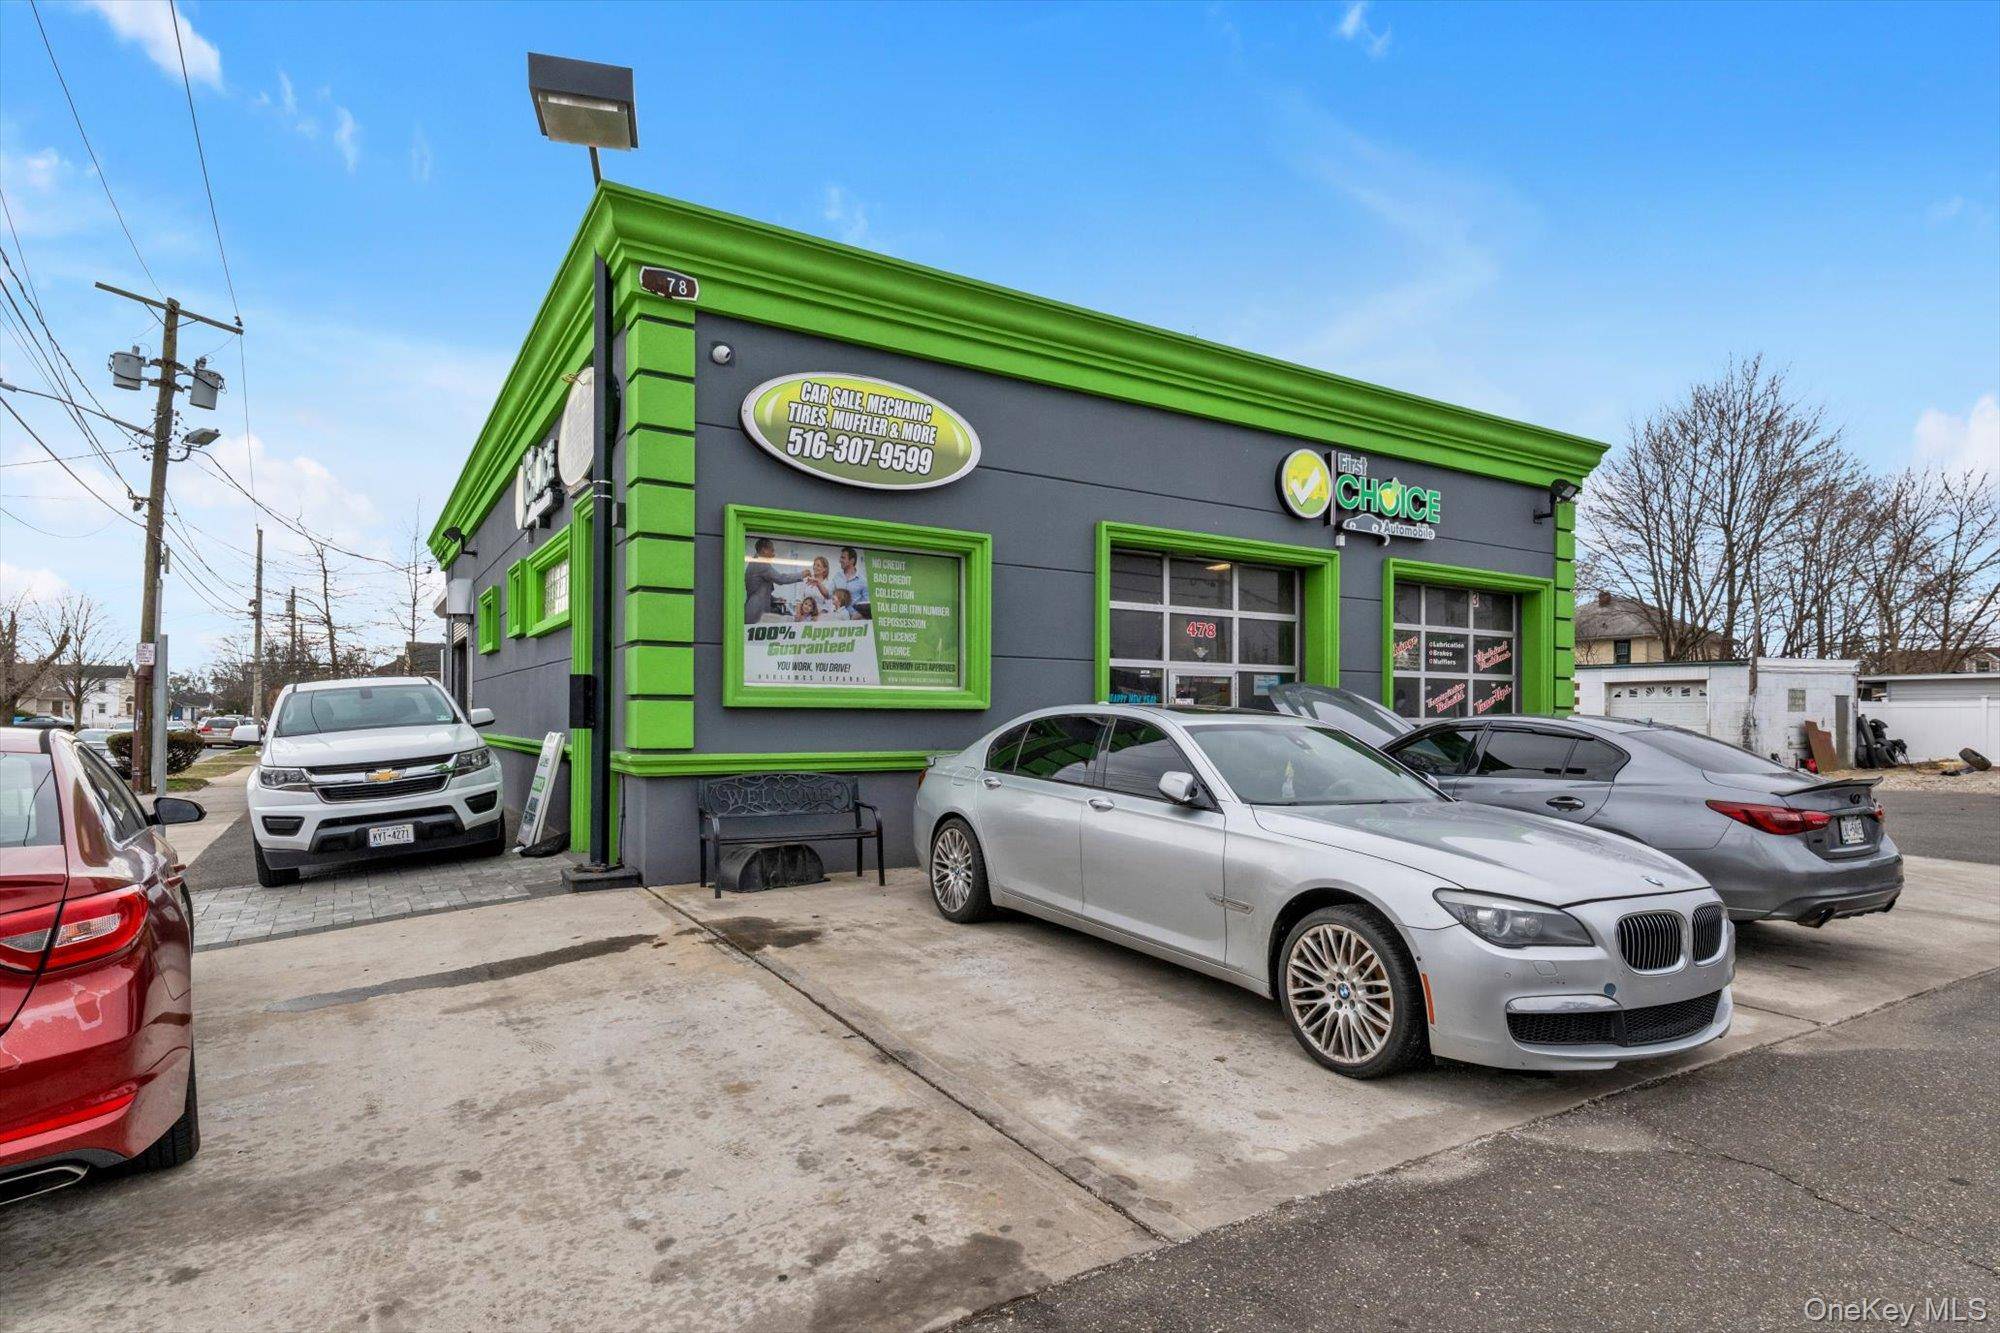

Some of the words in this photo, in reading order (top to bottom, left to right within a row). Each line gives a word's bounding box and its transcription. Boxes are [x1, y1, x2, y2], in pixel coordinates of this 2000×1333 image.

[801, 381, 830, 405] CAR
[831, 387, 865, 412] SALE,
[866, 393, 932, 423] MECHANIC
[788, 402, 829, 429] TIRES,
[831, 409, 888, 437] MUFFLER
[890, 422, 900, 439] &
[901, 421, 938, 445] MORE
[787, 427, 933, 475] 516-307-9599
[1338, 452, 1367, 476] First
[1336, 474, 1440, 523] CHOICE
[1383, 520, 1435, 540] Automobile
[872, 558, 882, 568] NO
[883, 559, 906, 571] CREDIT
[873, 573, 888, 583] BAD
[888, 574, 911, 586] CREDIT
[875, 587, 915, 600] COLLECTION
[899, 604, 909, 614] OR
[922, 605, 950, 617] NUMBER
[879, 617, 927, 629] REPOSSESSION
[1186, 621, 1217, 639] 478
[747, 625, 796, 641] 100%
[801, 624, 868, 641] Approval
[880, 631, 889, 641] NO
[767, 640, 855, 656] Guaranteed
[1433, 641, 1464, 649] Lubrication
[777, 661, 791, 671] YOU
[815, 662, 828, 672] YOU
[829, 663, 851, 673] DRIVE!
[882, 661, 913, 671] EVERYBODY
[915, 662, 928, 672] GETS
[928, 663, 956, 673] APPROVED
